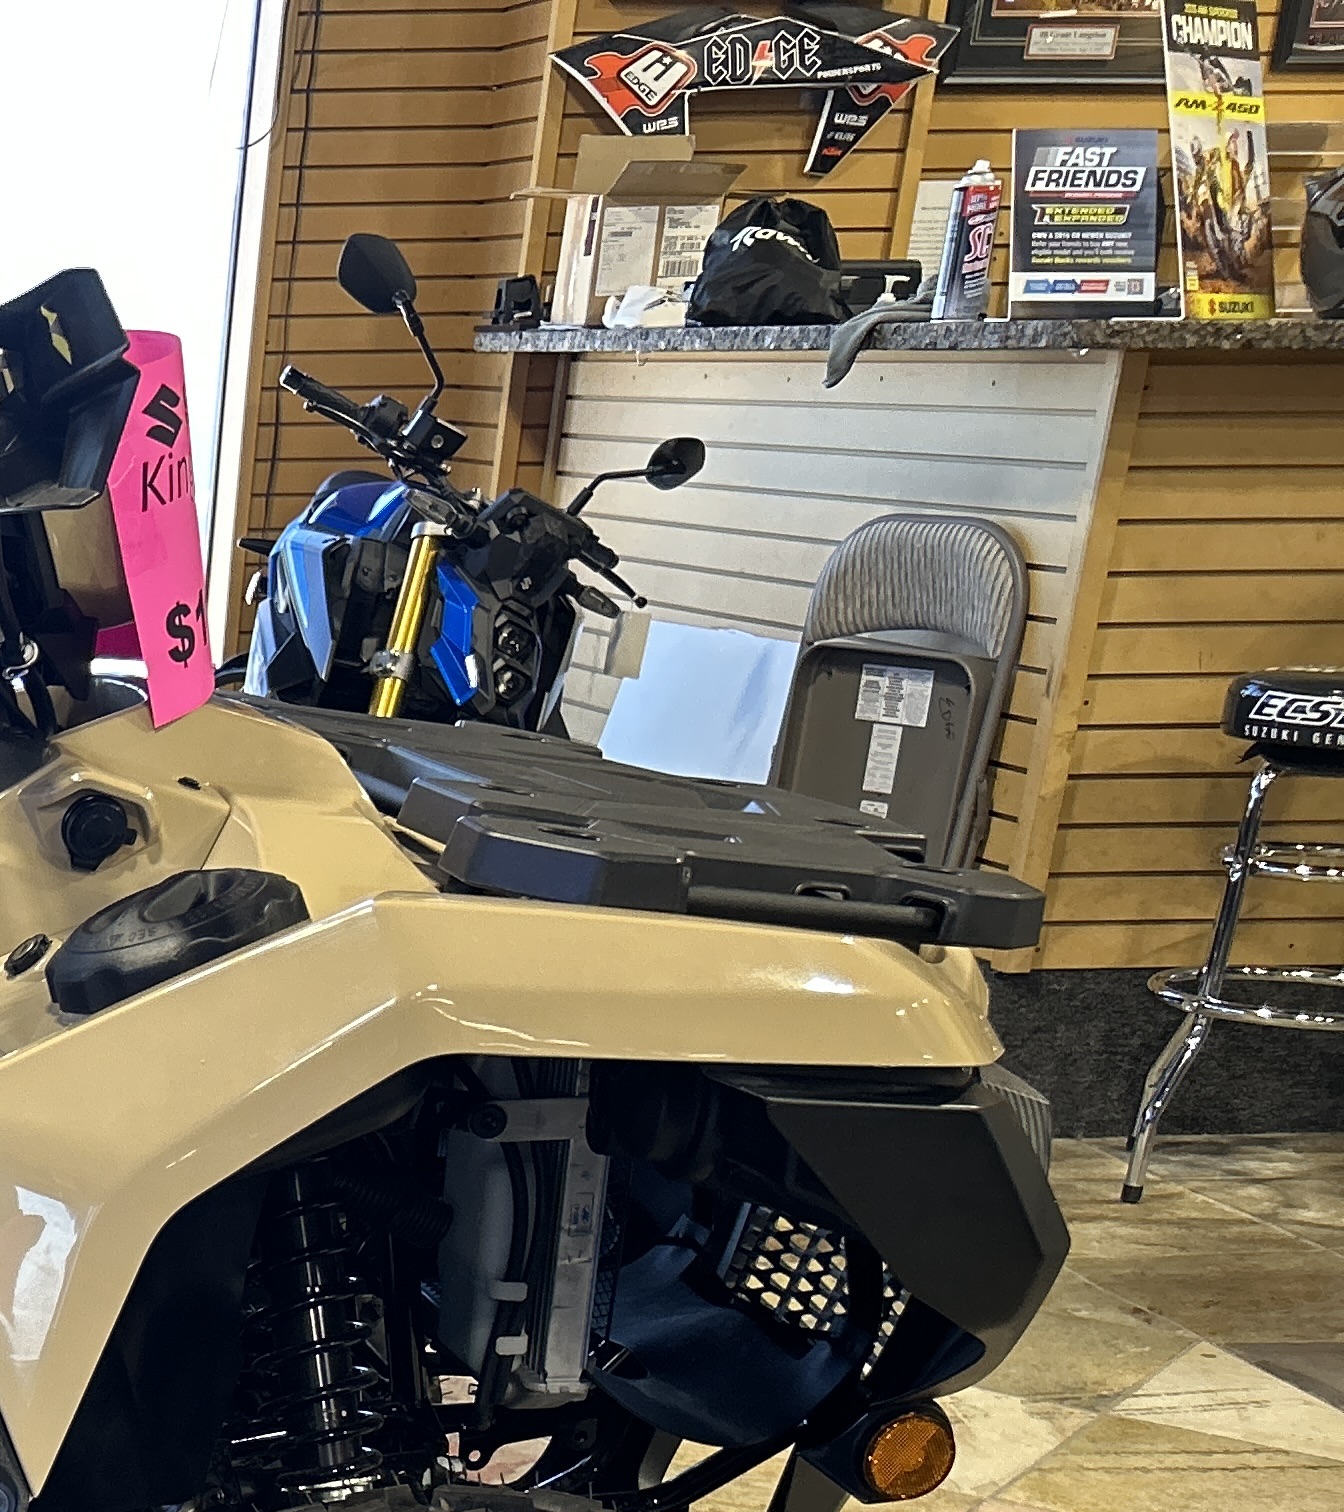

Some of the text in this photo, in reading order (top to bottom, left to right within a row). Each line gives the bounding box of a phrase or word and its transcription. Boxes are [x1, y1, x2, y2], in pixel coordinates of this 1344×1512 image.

[1171, 14, 1253, 50] CHAMPION
[817, 63, 882, 79] POWERSPORTS
[624, 70, 658, 101] EDGE
[1054, 146, 1117, 167] FAST
[1030, 170, 1138, 188] FRIENDS
[1218, 302, 1254, 313] SUZUKI
[1244, 724, 1298, 742] SUZUKI
